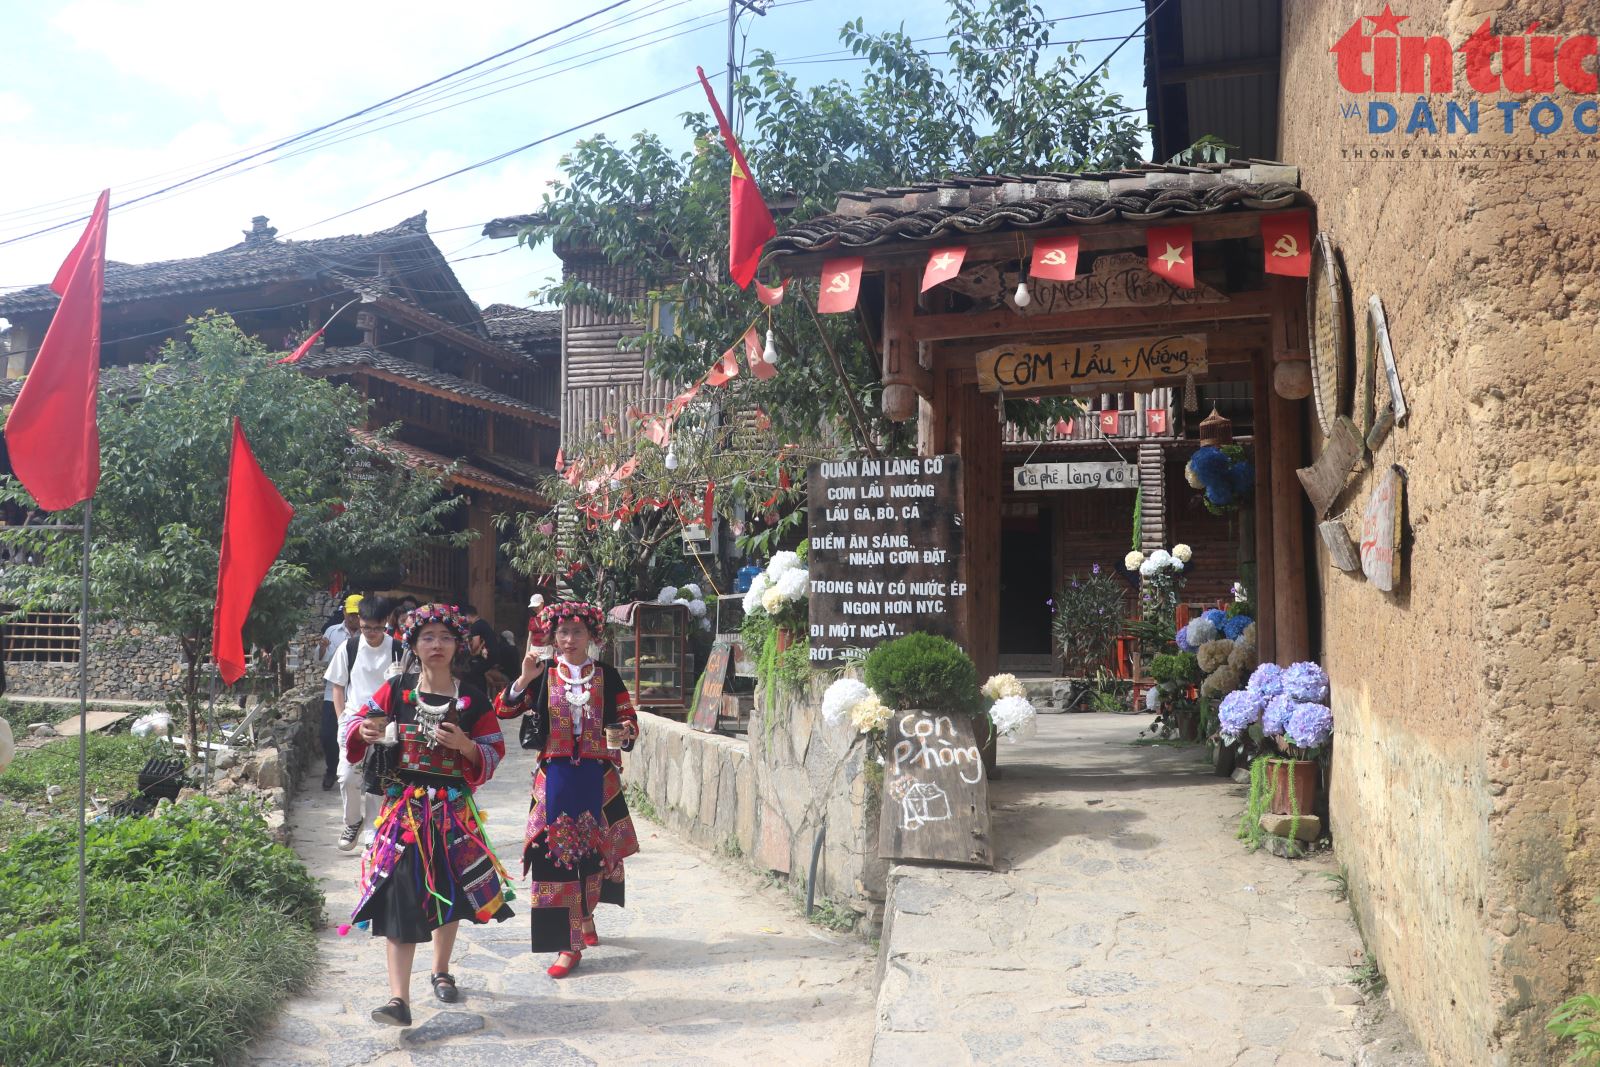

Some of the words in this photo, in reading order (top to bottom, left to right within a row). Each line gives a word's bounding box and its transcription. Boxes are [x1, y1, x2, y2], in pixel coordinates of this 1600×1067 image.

[885, 456, 920, 476] LÀNG
[924, 454, 944, 474] CỔ
[828, 486, 856, 500] CƠM
[861, 480, 884, 499] LẨU
[890, 479, 935, 498] NƯỚNG
[826, 503, 849, 521] LẨU
[812, 532, 845, 550] ĐIỂM
[849, 550, 884, 568] NHẬN
[889, 550, 919, 564] CƠM
[810, 580, 853, 594] TRONG
[857, 579, 884, 595] NÀY
[888, 578, 906, 595] CÓ
[950, 581, 967, 596] ÉP
[843, 601, 880, 615] NGON
[884, 600, 912, 614] HƠN
[810, 624, 824, 637] ĐI
[828, 622, 857, 641] MỘT
[809, 644, 834, 661] RỚT
